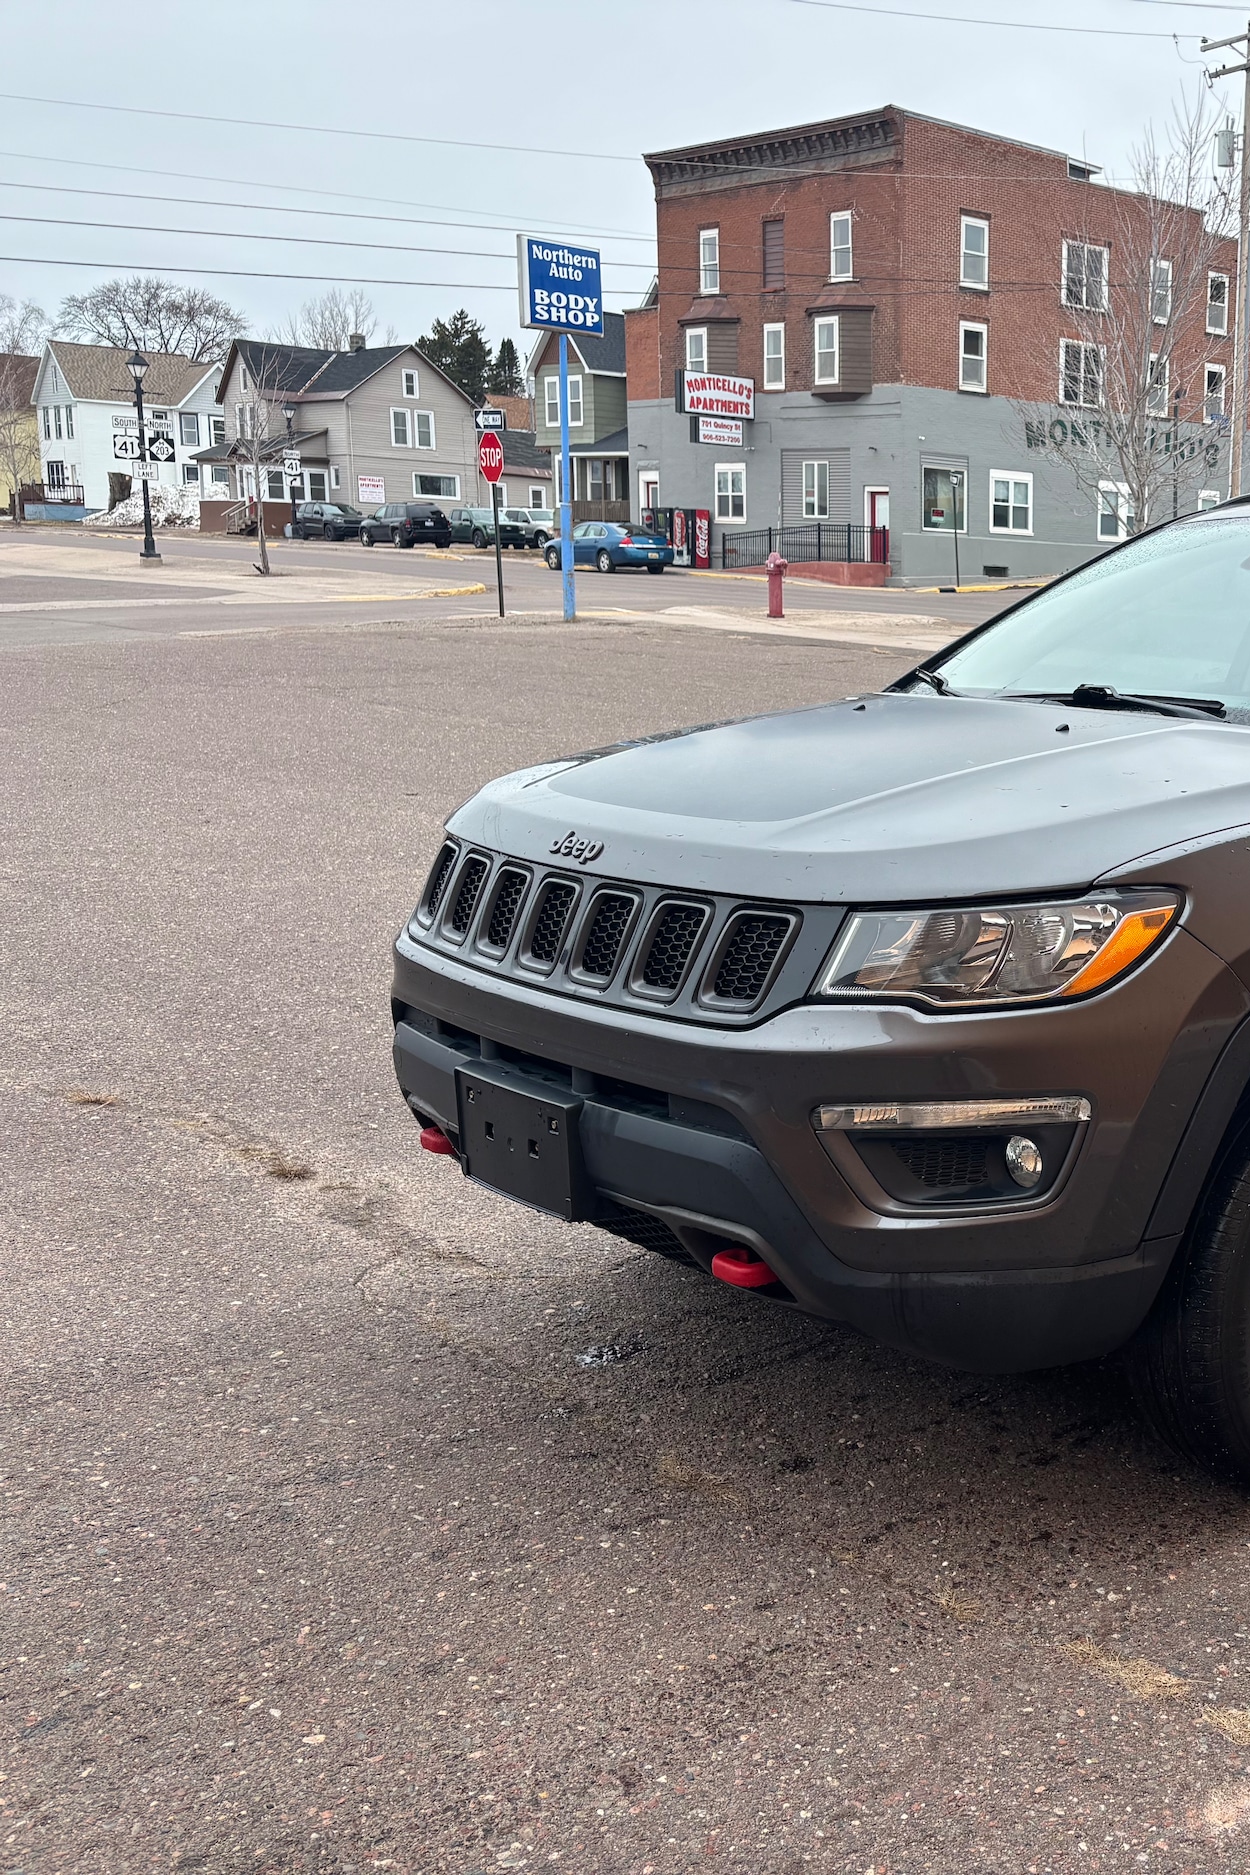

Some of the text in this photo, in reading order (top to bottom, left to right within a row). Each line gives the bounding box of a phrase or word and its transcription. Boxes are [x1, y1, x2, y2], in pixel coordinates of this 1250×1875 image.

[532, 244, 596, 270] Northern
[549, 263, 582, 281] Auto
[534, 289, 598, 312] BODY
[535, 305, 600, 327] SHOP
[686, 377, 752, 400] MONTICELLO'S
[689, 396, 750, 415] APARTMENTS
[114, 418, 136, 427] SOUTH
[150, 421, 171, 429] NORTH
[714, 421, 733, 431] Quincy
[119, 441, 134, 455] 41
[156, 446, 169, 455] 203
[481, 447, 501, 467] STOP
[288, 462, 298, 471] 41
[549, 830, 604, 865] Jeep
